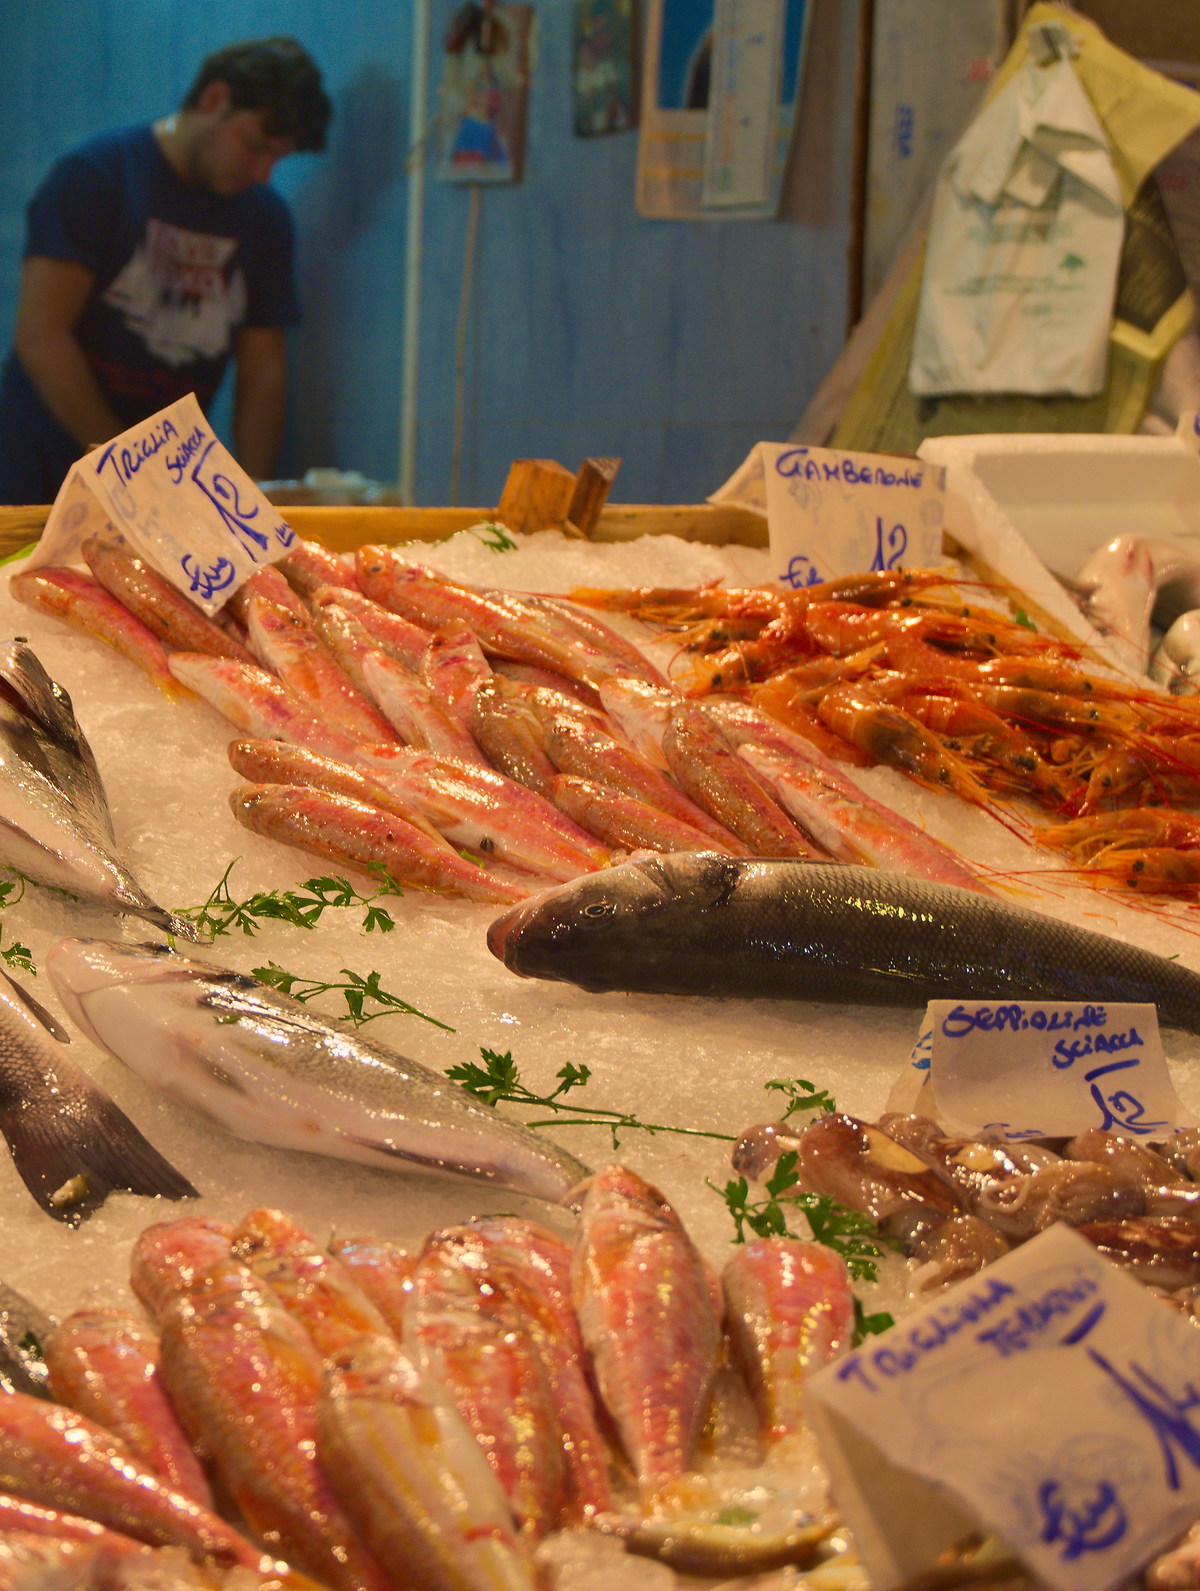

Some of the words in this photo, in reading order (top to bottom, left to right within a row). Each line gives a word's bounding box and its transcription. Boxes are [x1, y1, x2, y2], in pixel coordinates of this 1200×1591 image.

[775, 448, 924, 490] GAMBERONE
[869, 516, 908, 572] 12
[1085, 1059, 1169, 1134] 12
